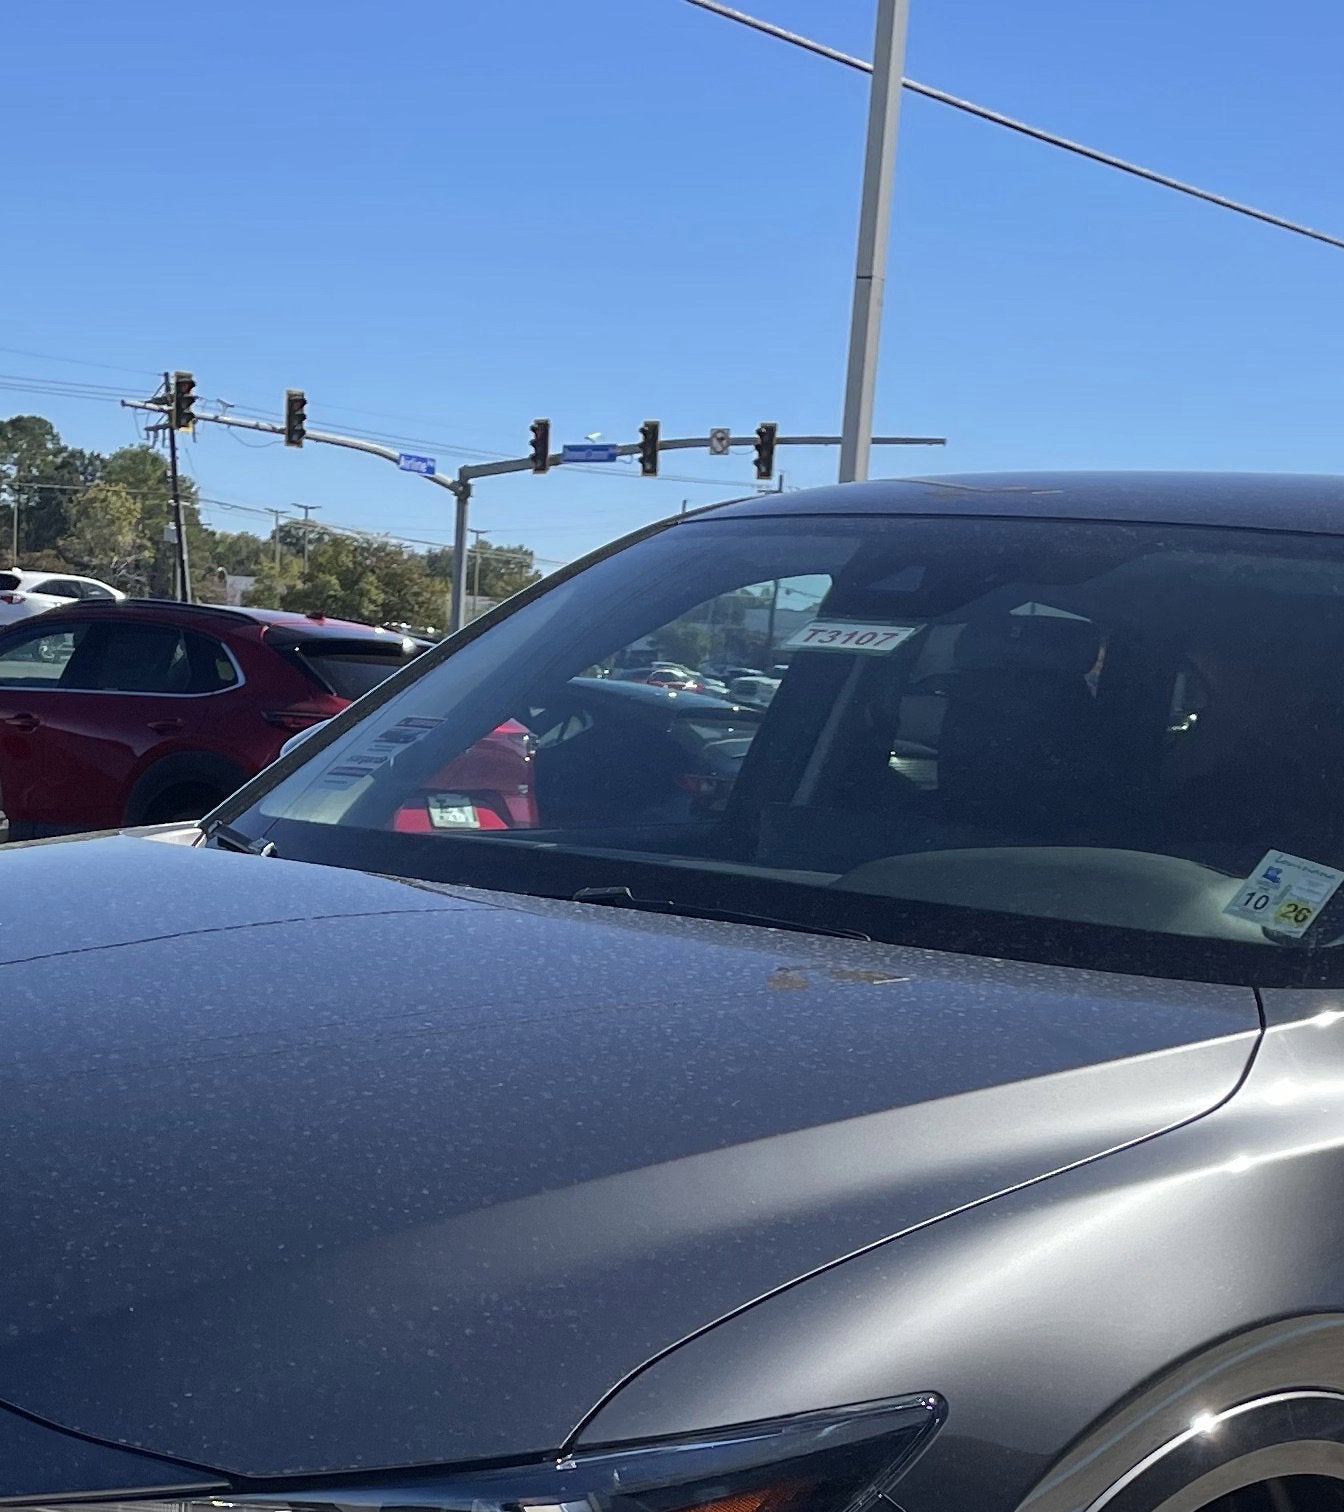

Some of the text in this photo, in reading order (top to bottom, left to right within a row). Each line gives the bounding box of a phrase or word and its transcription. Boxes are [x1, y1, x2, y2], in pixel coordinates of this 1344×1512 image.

[803, 628, 899, 647] T3107
[1243, 892, 1270, 910] 10
[1279, 903, 1312, 923] 26
